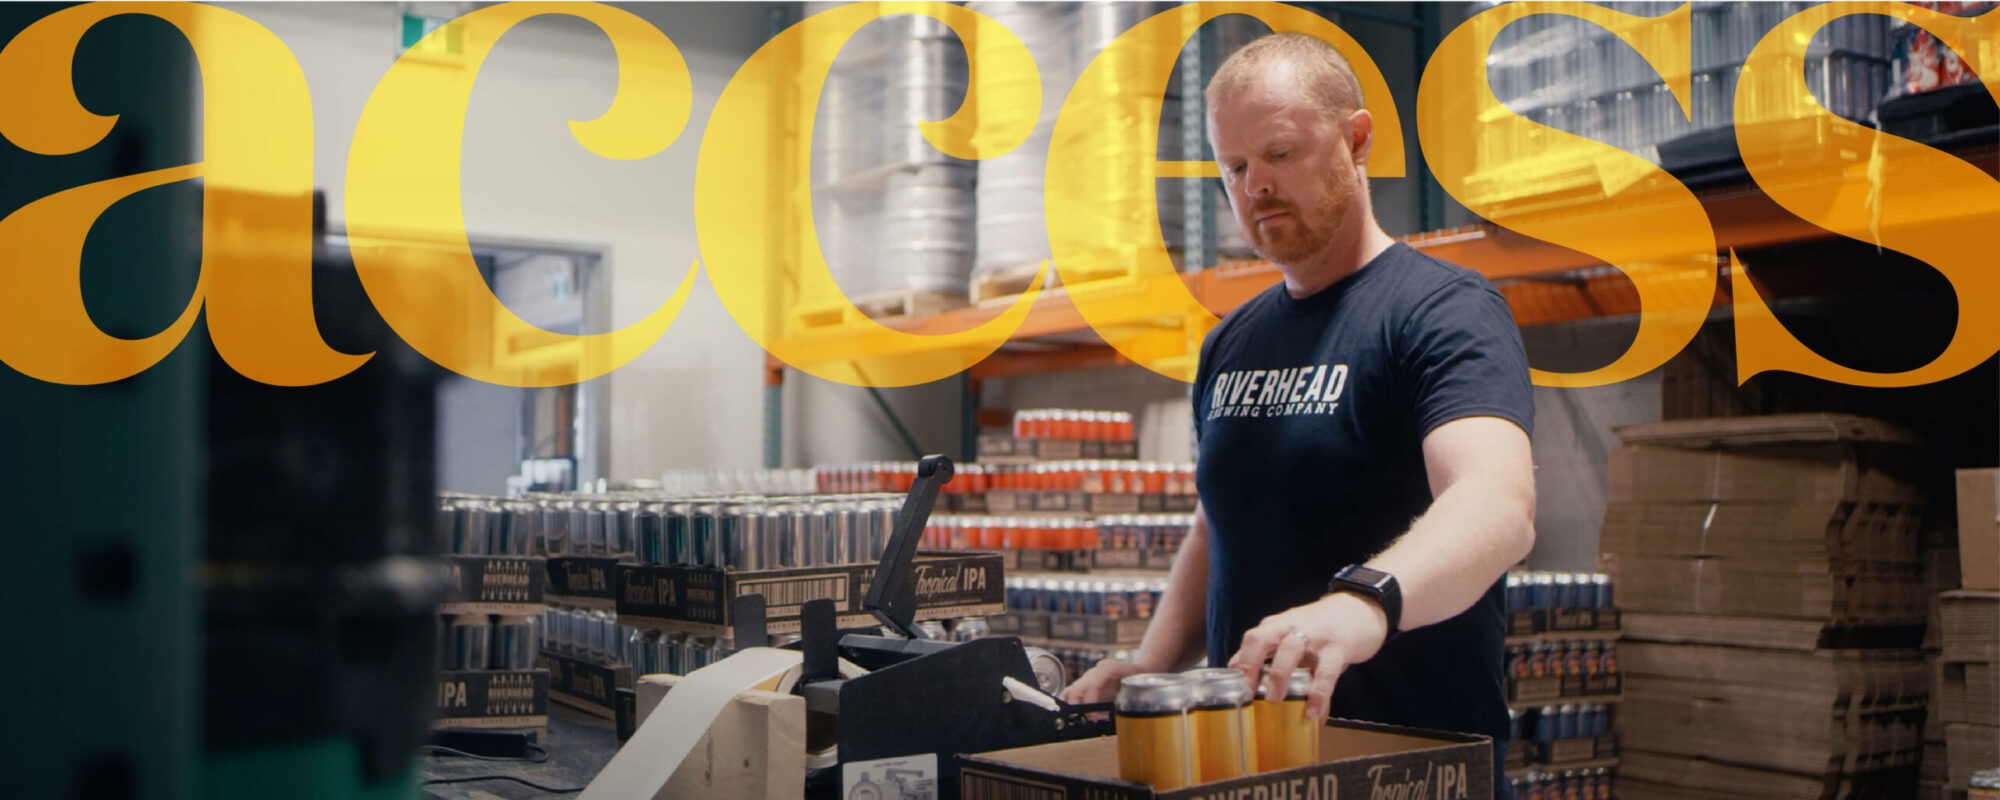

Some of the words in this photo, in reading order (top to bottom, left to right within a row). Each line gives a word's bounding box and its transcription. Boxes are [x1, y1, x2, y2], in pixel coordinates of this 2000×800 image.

[1211, 364, 1349, 409] RIVERHEAD
[1266, 402, 1339, 417] COMPANY
[482, 573, 530, 586] RIVERHEAD
[657, 577, 677, 607] IPA
[914, 563, 962, 600] Tropical
[963, 566, 987, 591] IPA
[437, 681, 468, 708] IPA
[487, 687, 535, 699] RIVERHEAD
[1437, 762, 1468, 800] IPA
